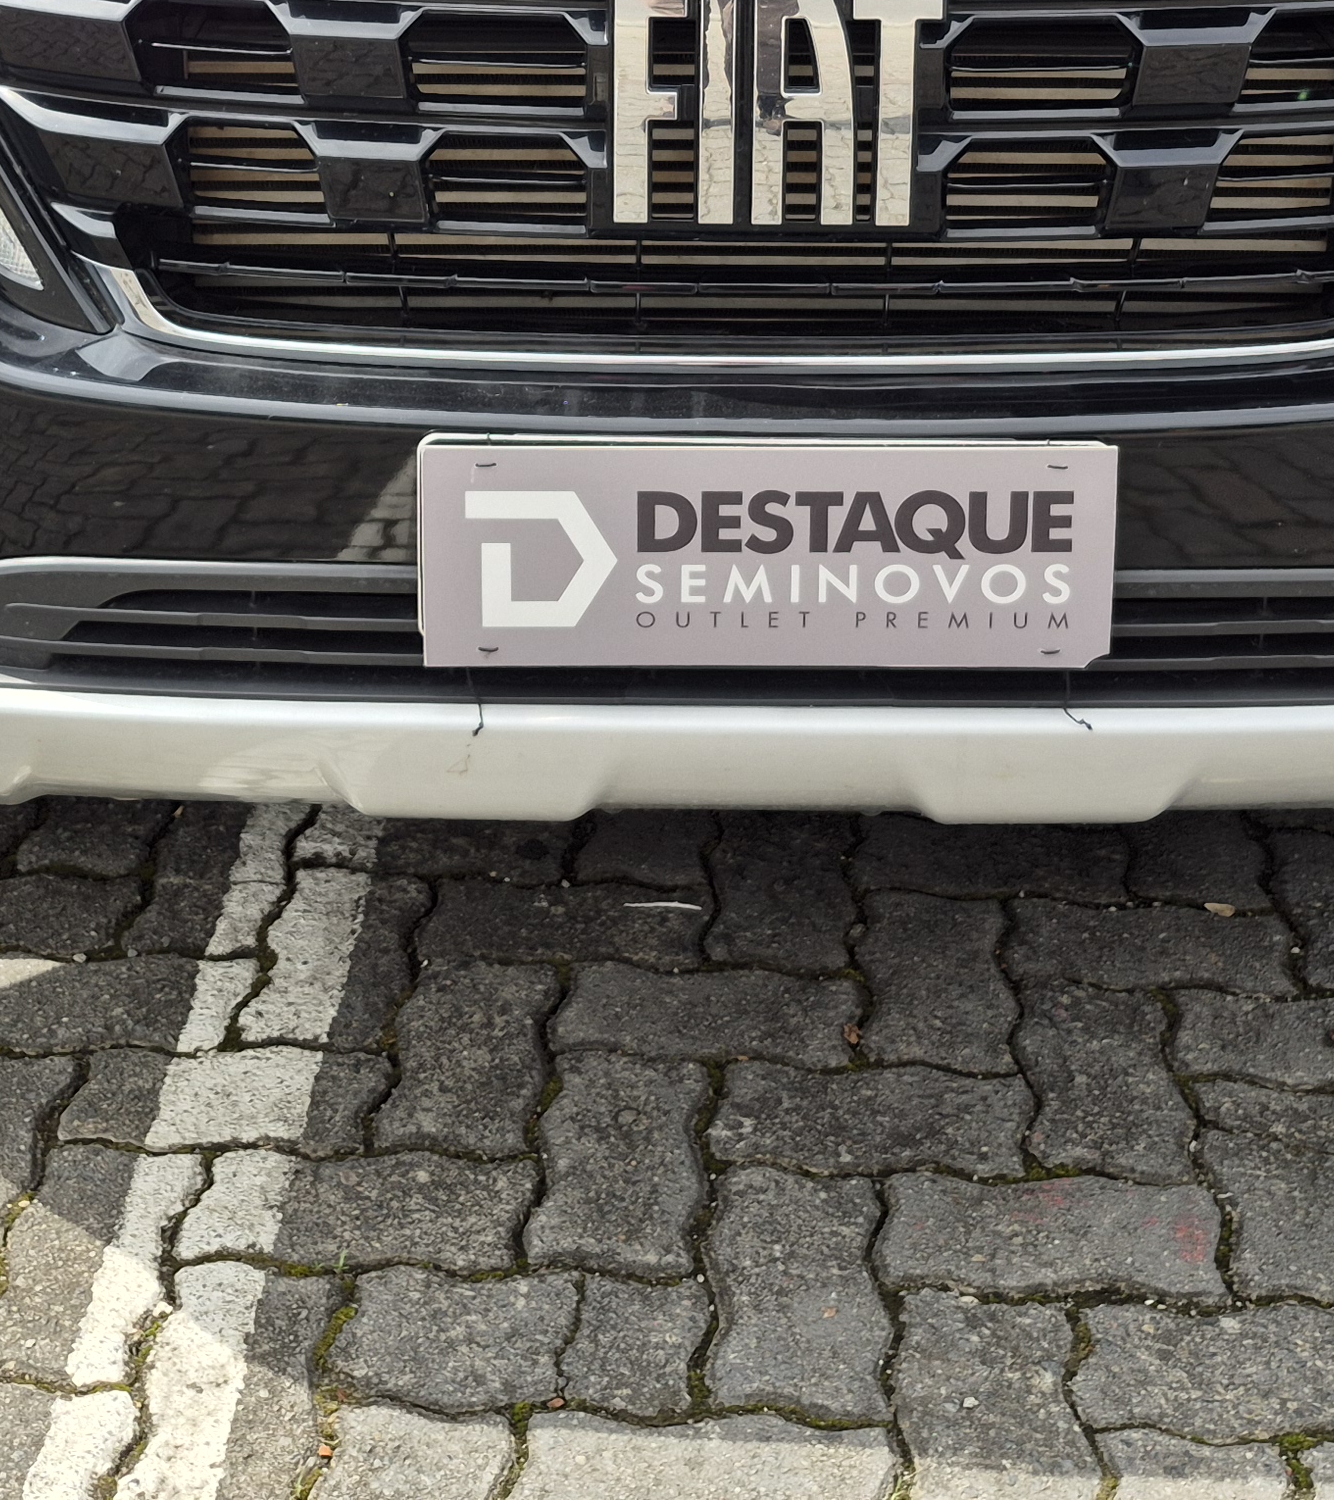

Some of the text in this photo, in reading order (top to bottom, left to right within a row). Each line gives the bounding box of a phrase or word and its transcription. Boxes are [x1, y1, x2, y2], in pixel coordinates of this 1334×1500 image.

[636, 490, 1075, 560] DESTAQUE
[635, 563, 1073, 605] SEMINOVOS
[636, 611, 1071, 630] OUTLET PREMIUM
